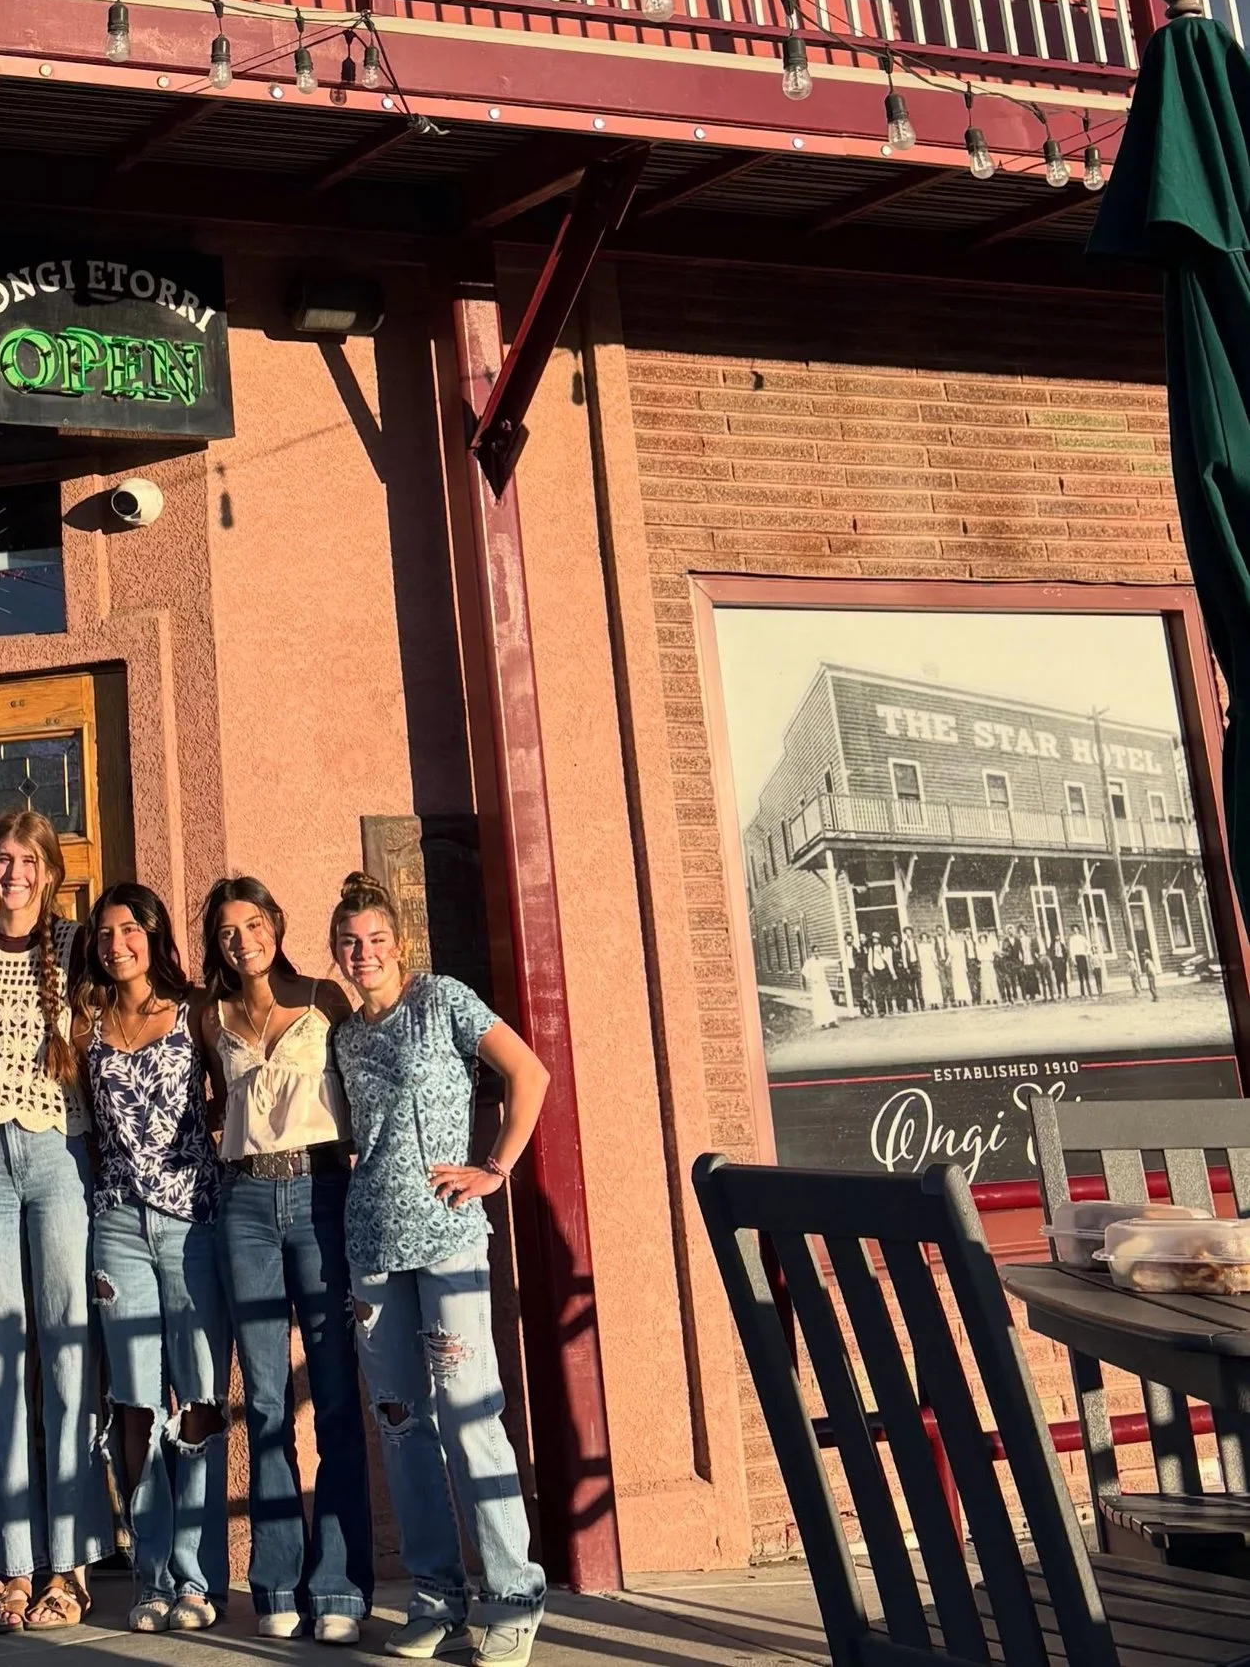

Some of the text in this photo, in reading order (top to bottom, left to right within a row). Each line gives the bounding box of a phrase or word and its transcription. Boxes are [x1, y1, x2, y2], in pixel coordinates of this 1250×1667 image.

[86, 260, 217, 333] ETORRI
[875, 703, 1164, 776] THE STAR HOTEL
[933, 1060, 1080, 1082] ESTABLISHED 1910
[870, 1088, 1007, 1185] Ongi
